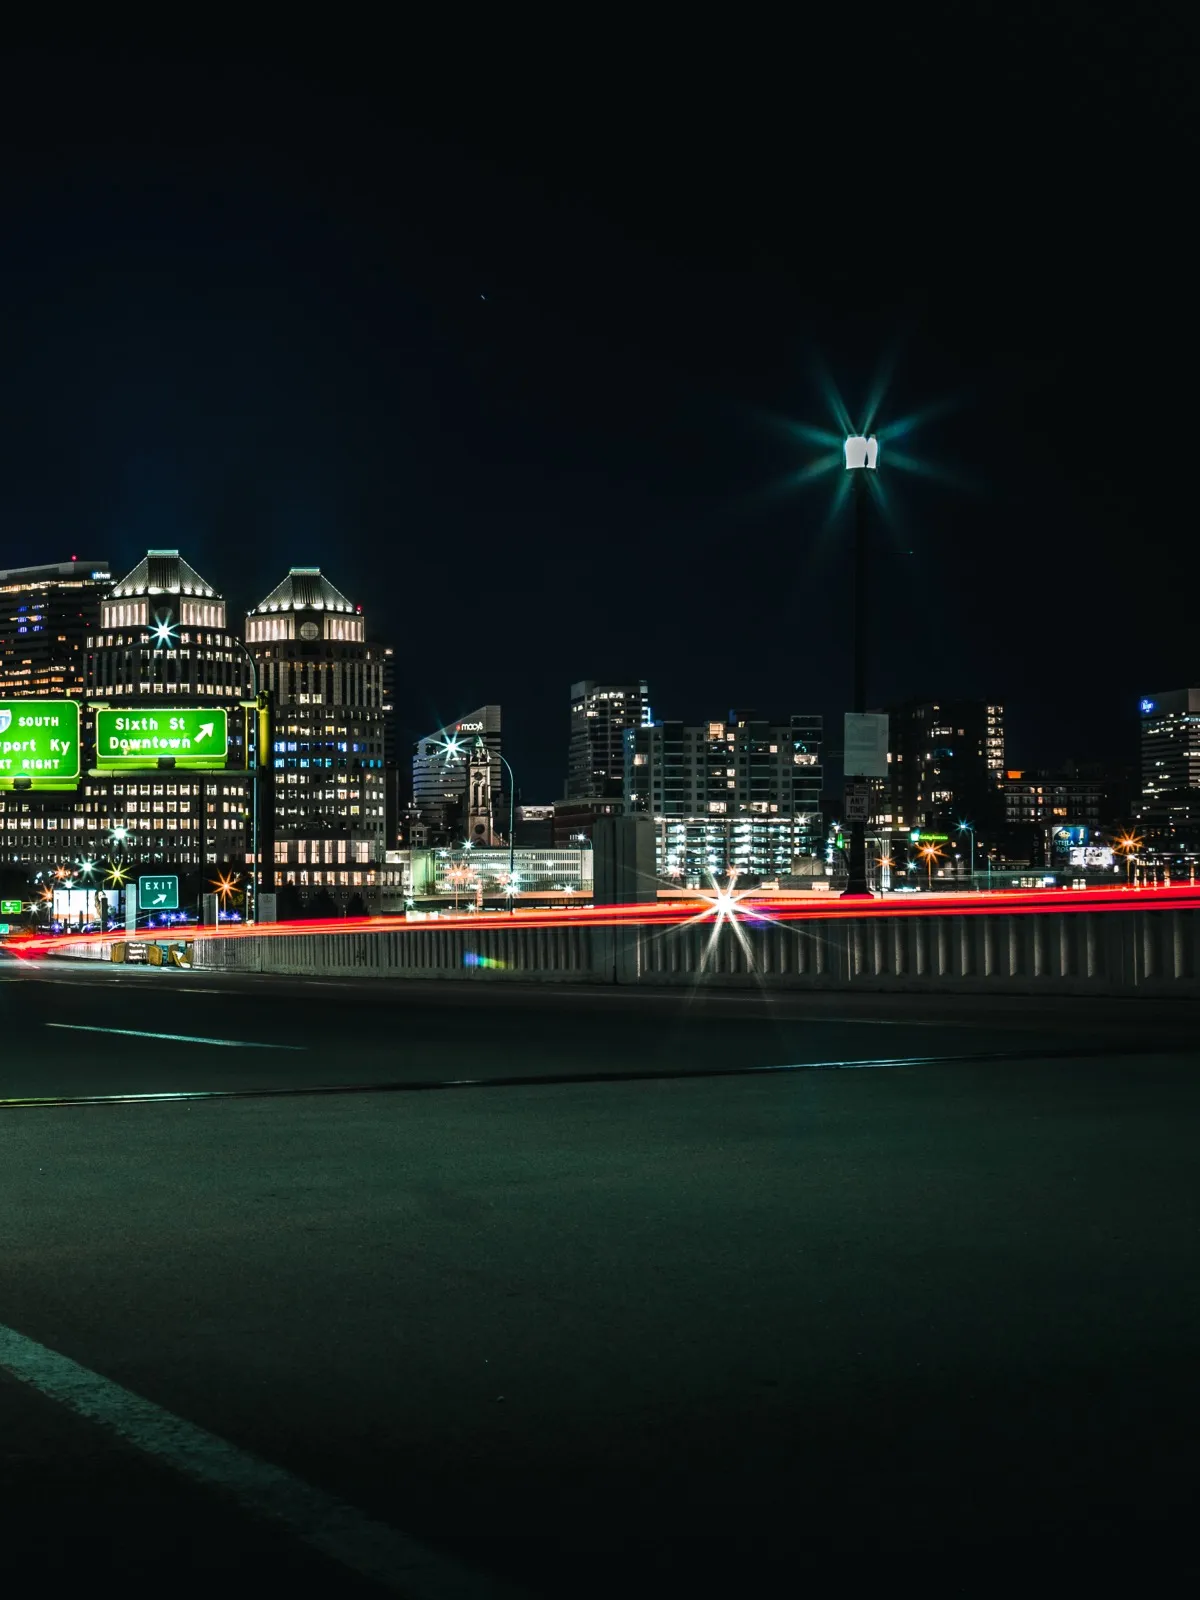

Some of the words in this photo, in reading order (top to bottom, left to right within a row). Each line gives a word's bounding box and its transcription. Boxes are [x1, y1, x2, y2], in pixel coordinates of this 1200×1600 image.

[18, 717, 59, 726] SOUTH
[115, 718, 158, 730] Sixth
[169, 718, 185, 730] St
[50, 739, 70, 755] Ky
[109, 736, 191, 749] Downtown
[22, 759, 60, 769] RIGHT
[145, 881, 172, 890] EXIT
